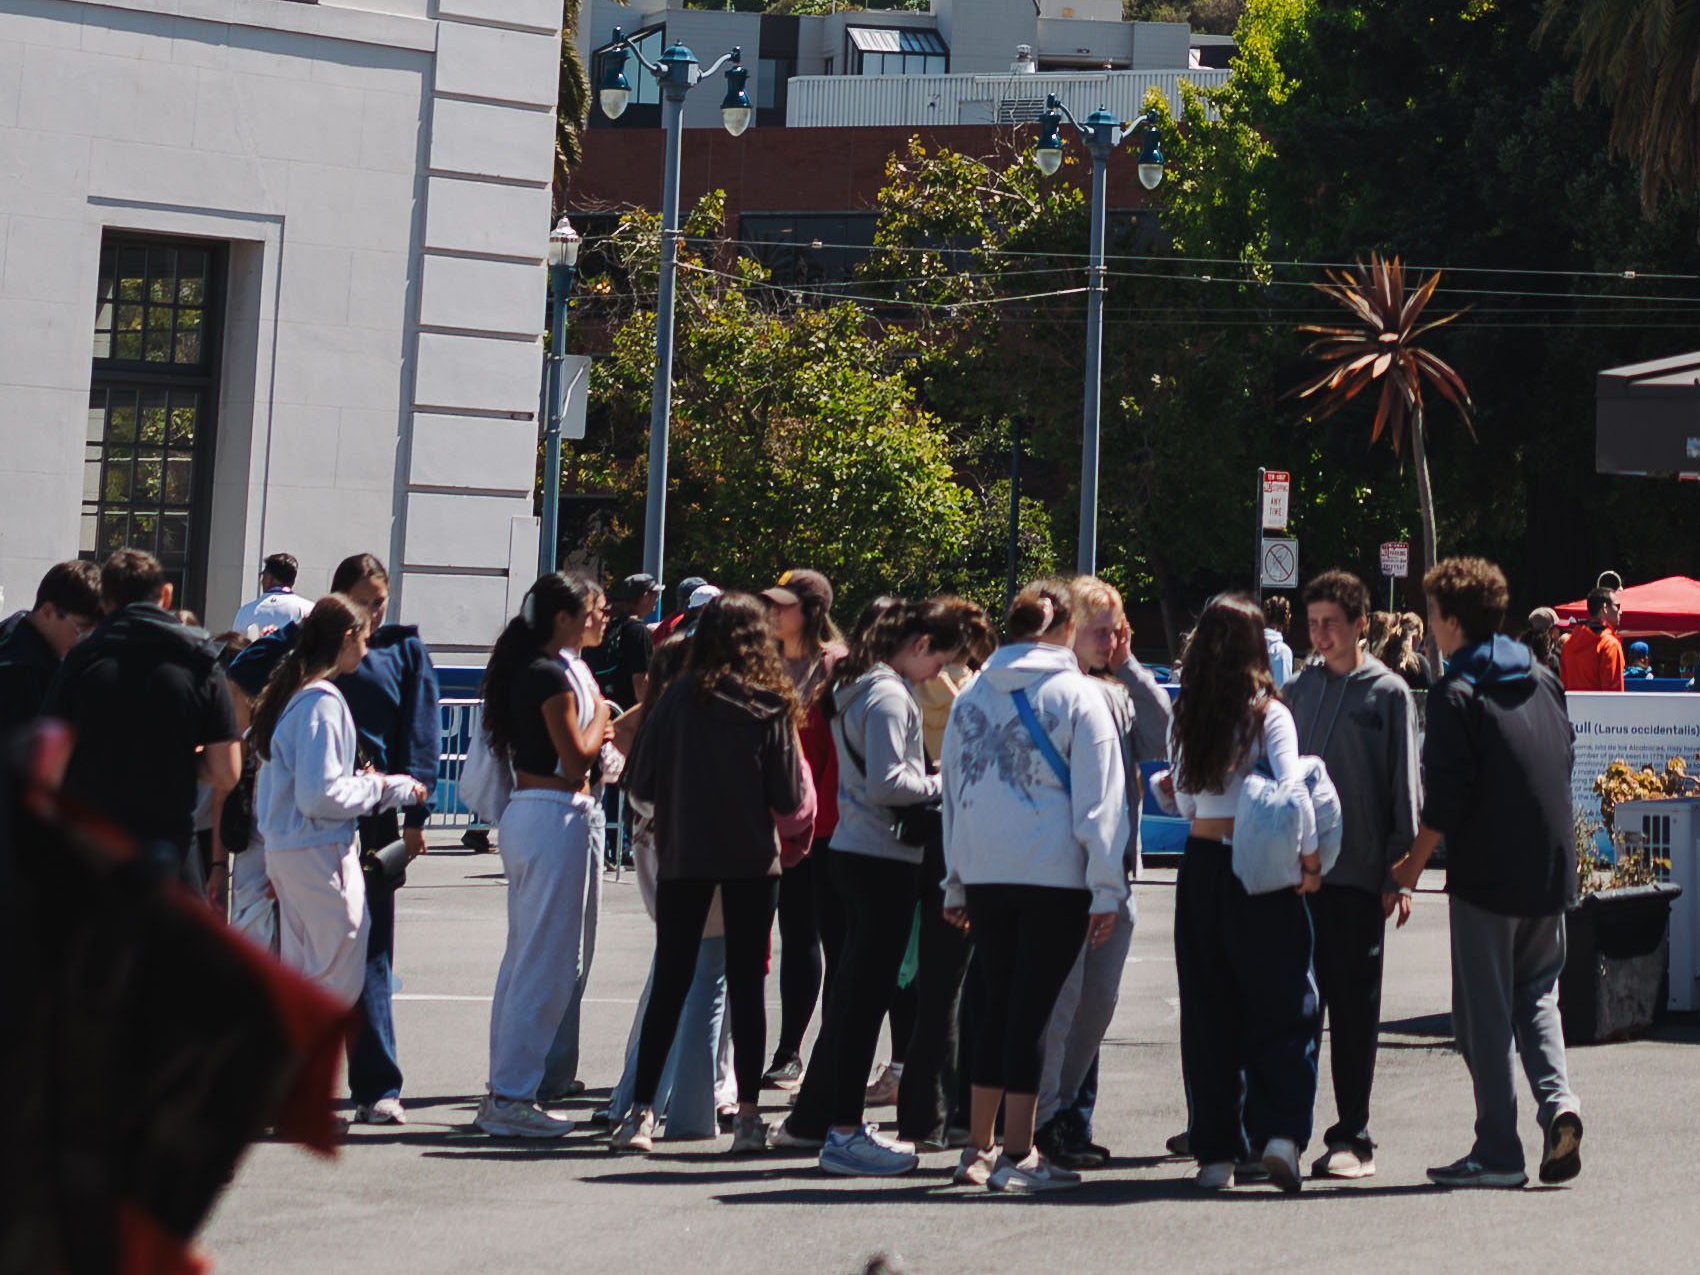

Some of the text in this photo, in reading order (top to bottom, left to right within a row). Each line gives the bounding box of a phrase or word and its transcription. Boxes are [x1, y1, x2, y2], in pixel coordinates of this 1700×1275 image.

[1575, 721, 1700, 737] ull (Larus occidentalis)
